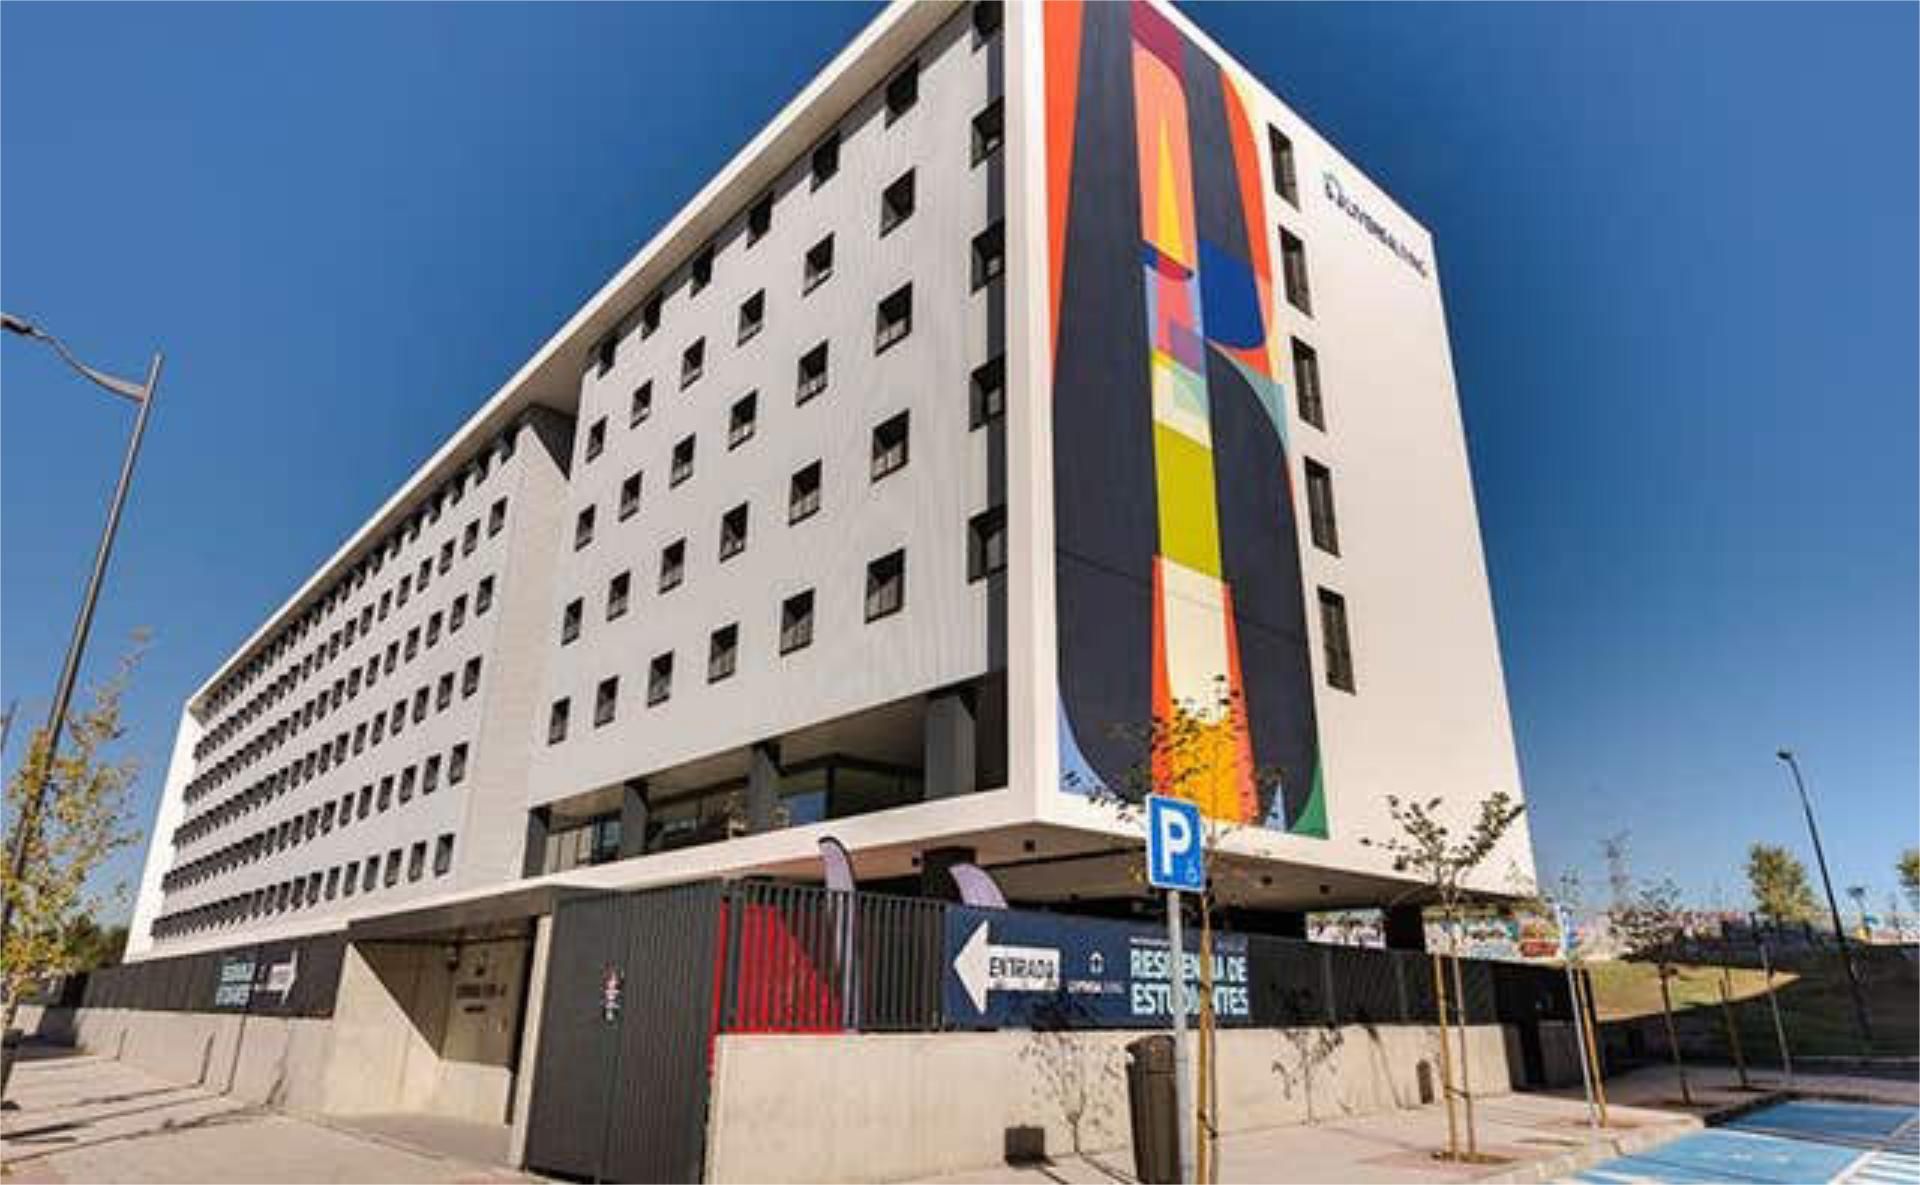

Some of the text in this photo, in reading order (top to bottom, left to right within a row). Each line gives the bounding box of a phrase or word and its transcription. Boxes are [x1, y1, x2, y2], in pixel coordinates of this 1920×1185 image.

[1161, 809, 1191, 876] P
[989, 957, 1054, 979] ENTRADA
[1131, 949, 1248, 982] RESIENIA DE
